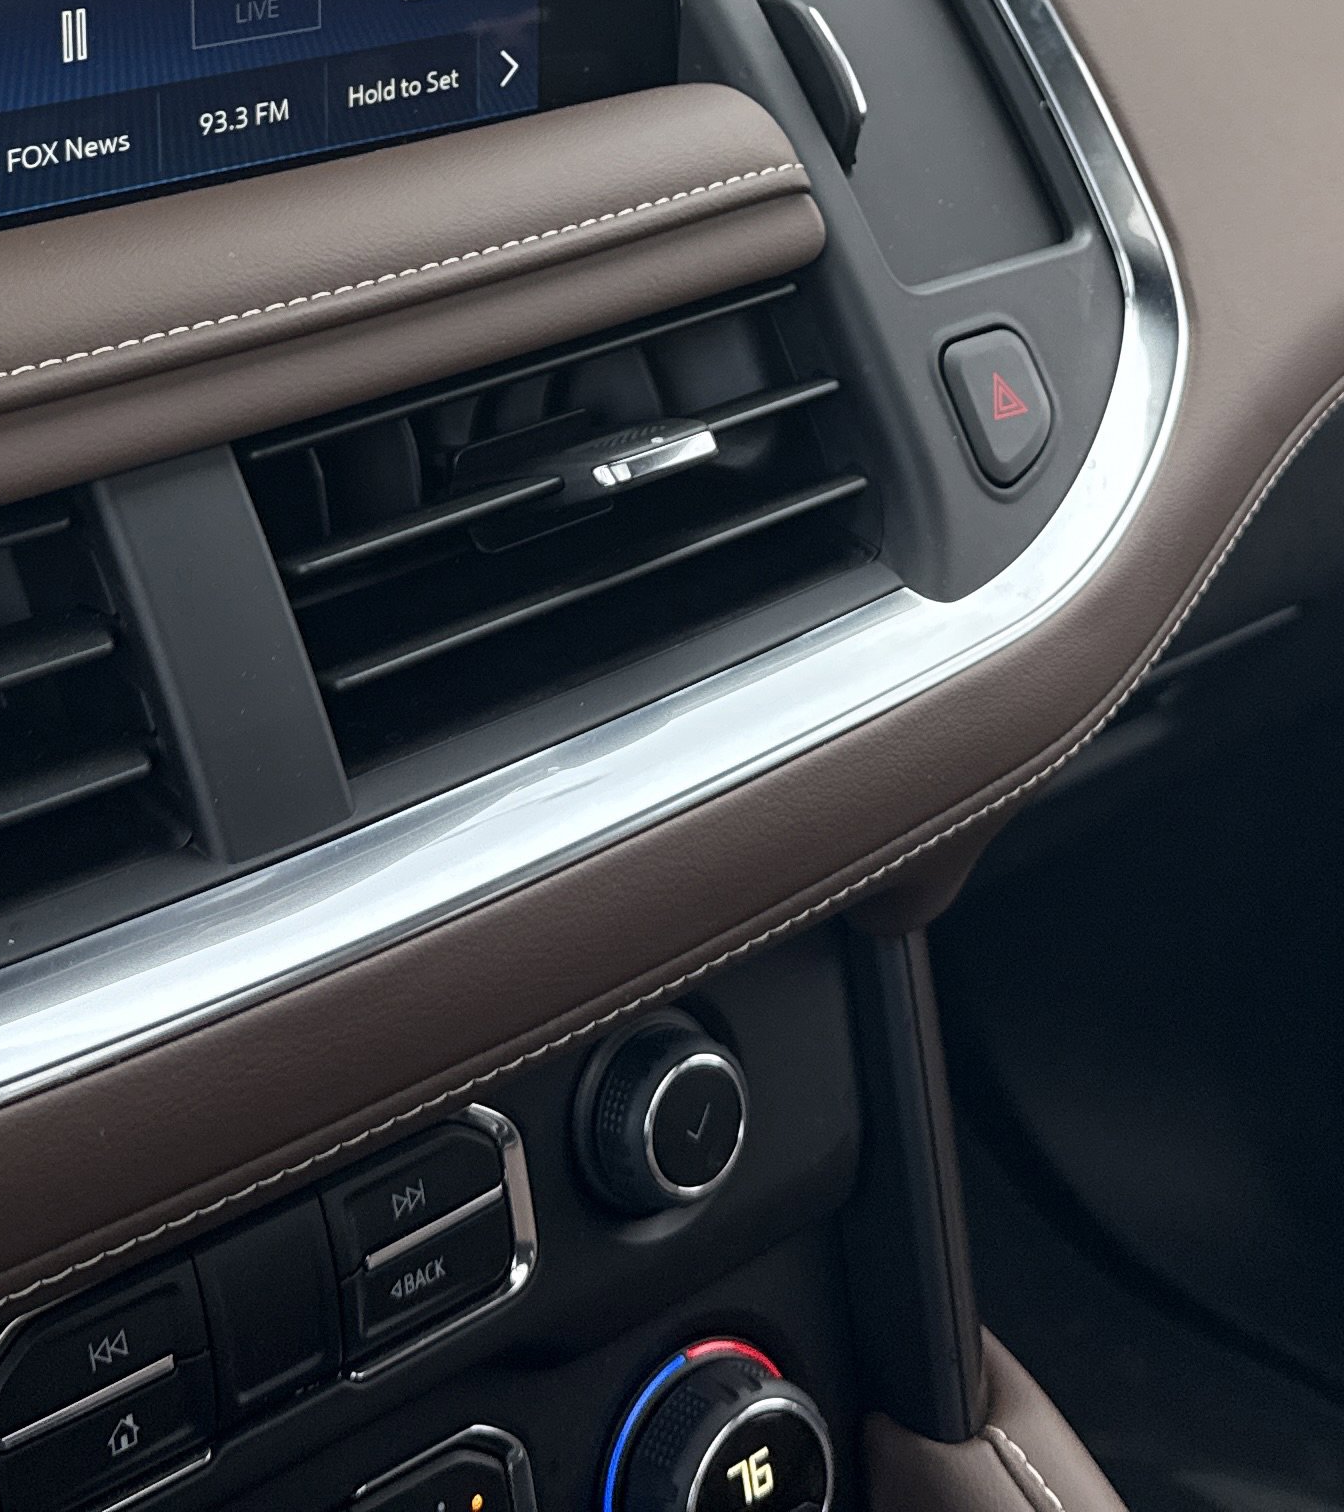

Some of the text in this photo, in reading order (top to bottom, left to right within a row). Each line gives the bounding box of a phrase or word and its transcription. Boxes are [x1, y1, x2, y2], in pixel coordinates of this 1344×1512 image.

[348, 69, 460, 108] Hold to Set
[199, 98, 291, 136] 93.3 FM
[6, 133, 132, 173] FOX News
[403, 1255, 446, 1295] BACK
[726, 1445, 775, 1505] 76
